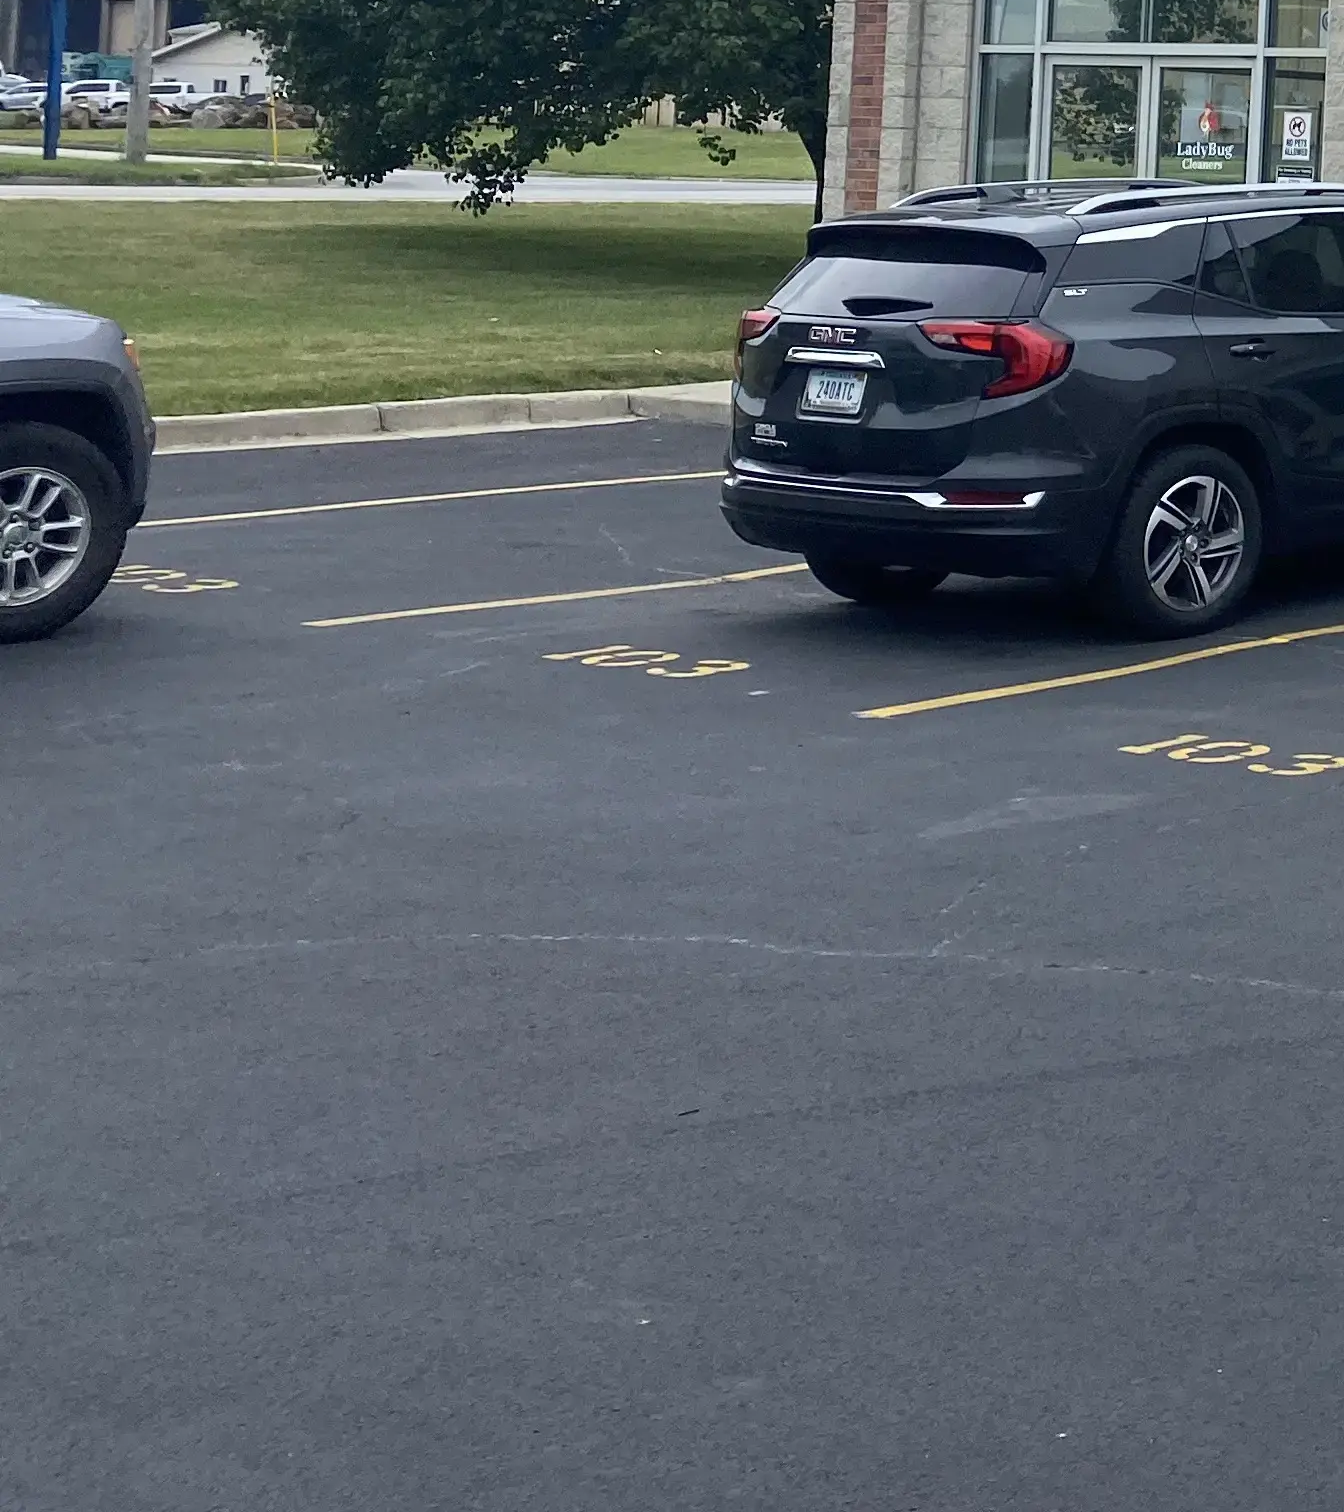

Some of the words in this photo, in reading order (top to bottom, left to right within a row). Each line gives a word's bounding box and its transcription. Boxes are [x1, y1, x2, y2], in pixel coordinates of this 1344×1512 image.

[1177, 142, 1234, 159] LadyBug
[1181, 158, 1223, 170] Cleaners
[809, 326, 857, 344] GMC
[541, 645, 750, 677] 103
